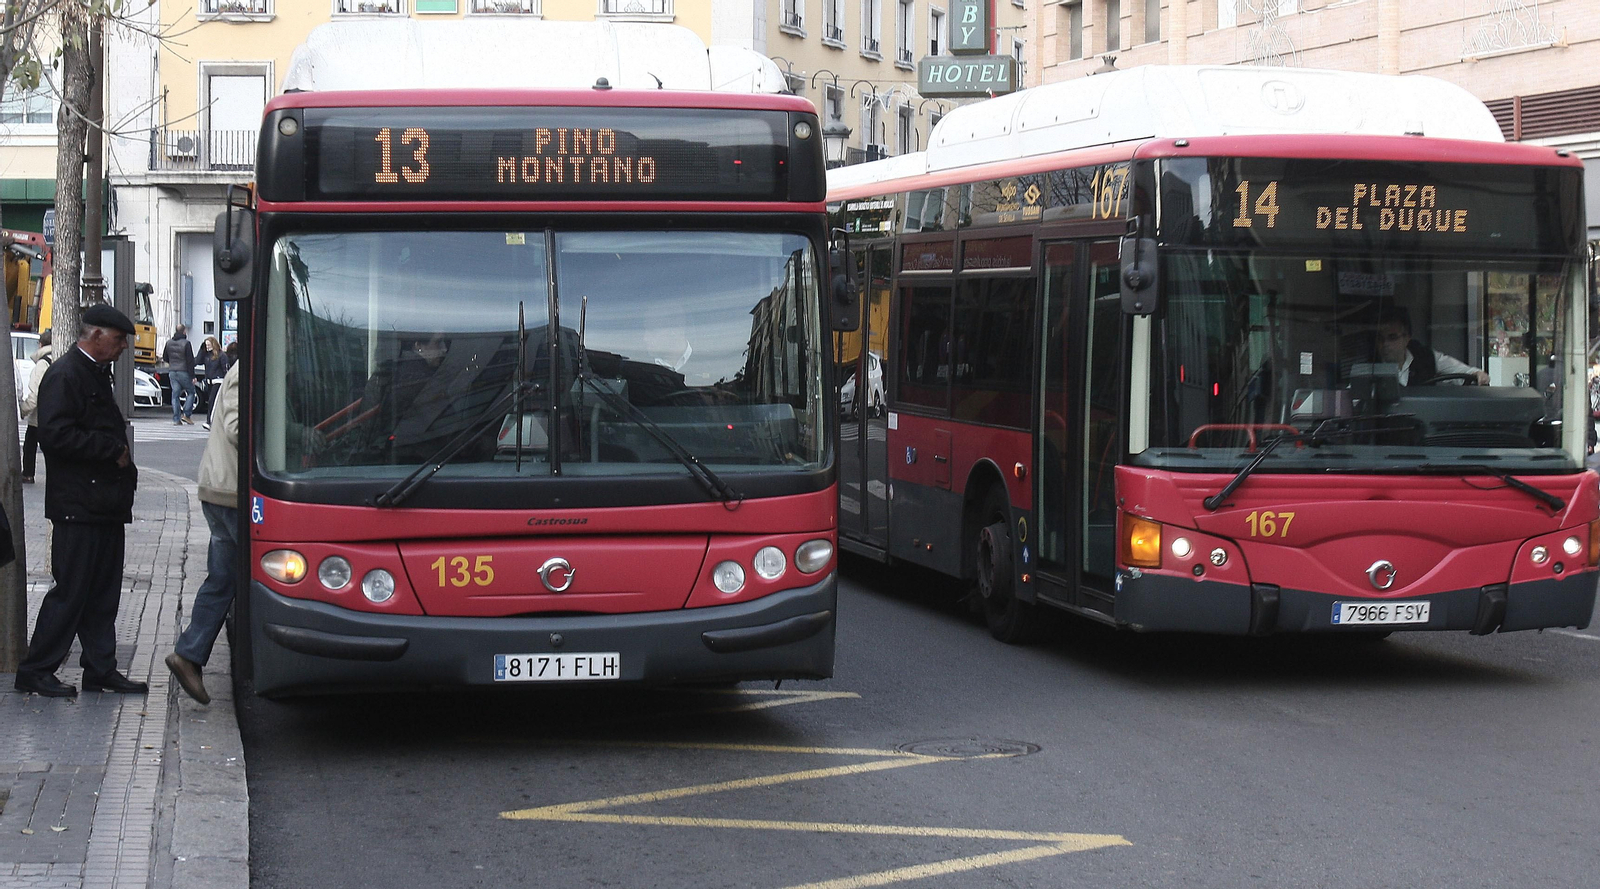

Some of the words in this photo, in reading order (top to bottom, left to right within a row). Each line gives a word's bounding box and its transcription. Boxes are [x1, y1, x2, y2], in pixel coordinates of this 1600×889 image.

[960, 0, 978, 45] BY
[927, 63, 1008, 83] HOTEL
[535, 128, 616, 155] PINO
[375, 127, 431, 184] 13
[497, 155, 656, 184] MONTANO
[1091, 168, 1128, 219] 167
[1233, 180, 1280, 228] 14
[1353, 183, 1437, 208] PLAZA
[1316, 206, 1363, 230] DEL
[1379, 208, 1468, 232] DUQUE
[527, 516, 588, 526] Castrosua
[1245, 510, 1295, 537] 167
[431, 555, 495, 587] 135
[1347, 604, 1389, 622] 7966
[1393, 603, 1425, 621] FSV
[508, 657, 562, 678] 8171
[574, 656, 616, 678] FLH
